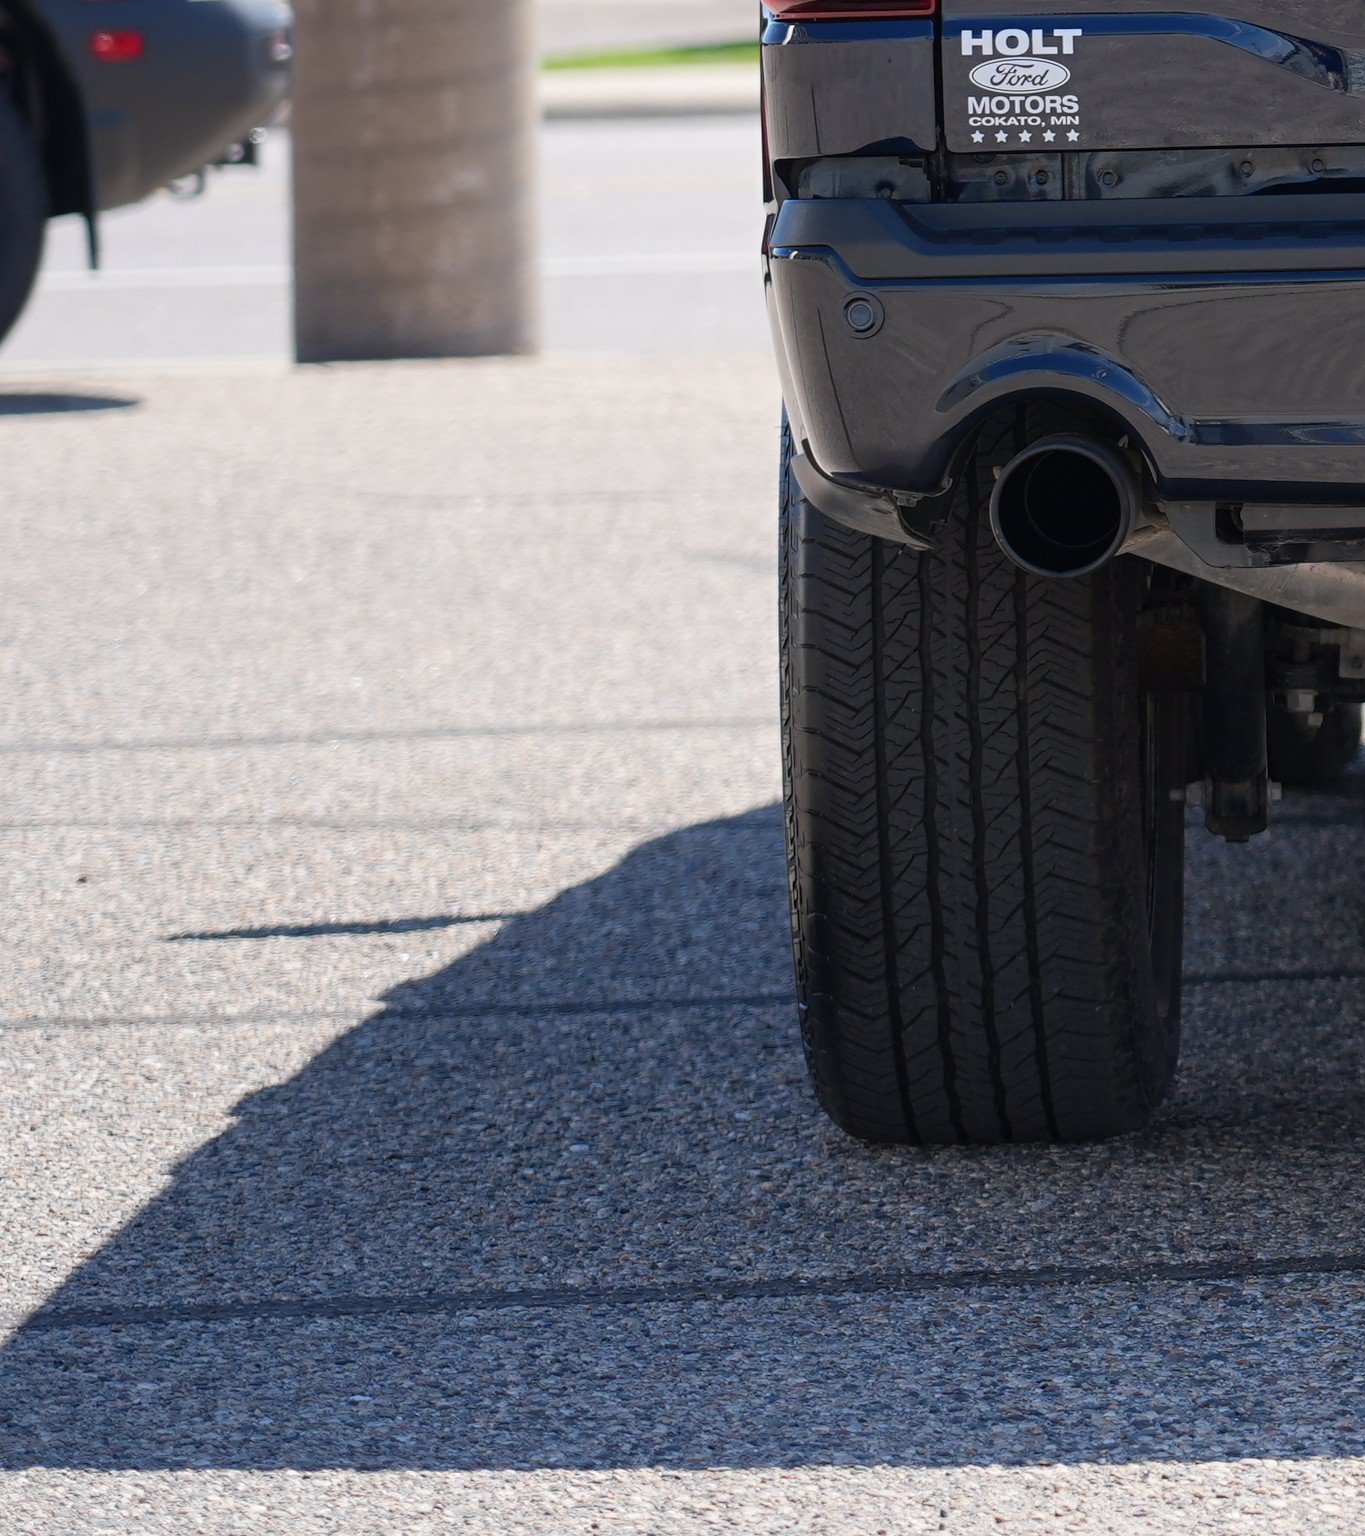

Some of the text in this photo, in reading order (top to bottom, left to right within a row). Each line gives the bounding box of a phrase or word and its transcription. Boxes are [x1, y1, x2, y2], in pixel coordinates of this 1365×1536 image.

[961, 28, 1083, 56] HOLT
[990, 63, 1049, 87] Ford
[967, 95, 1080, 115] MOTORS
[968, 115, 1080, 128] COKATO, MN
